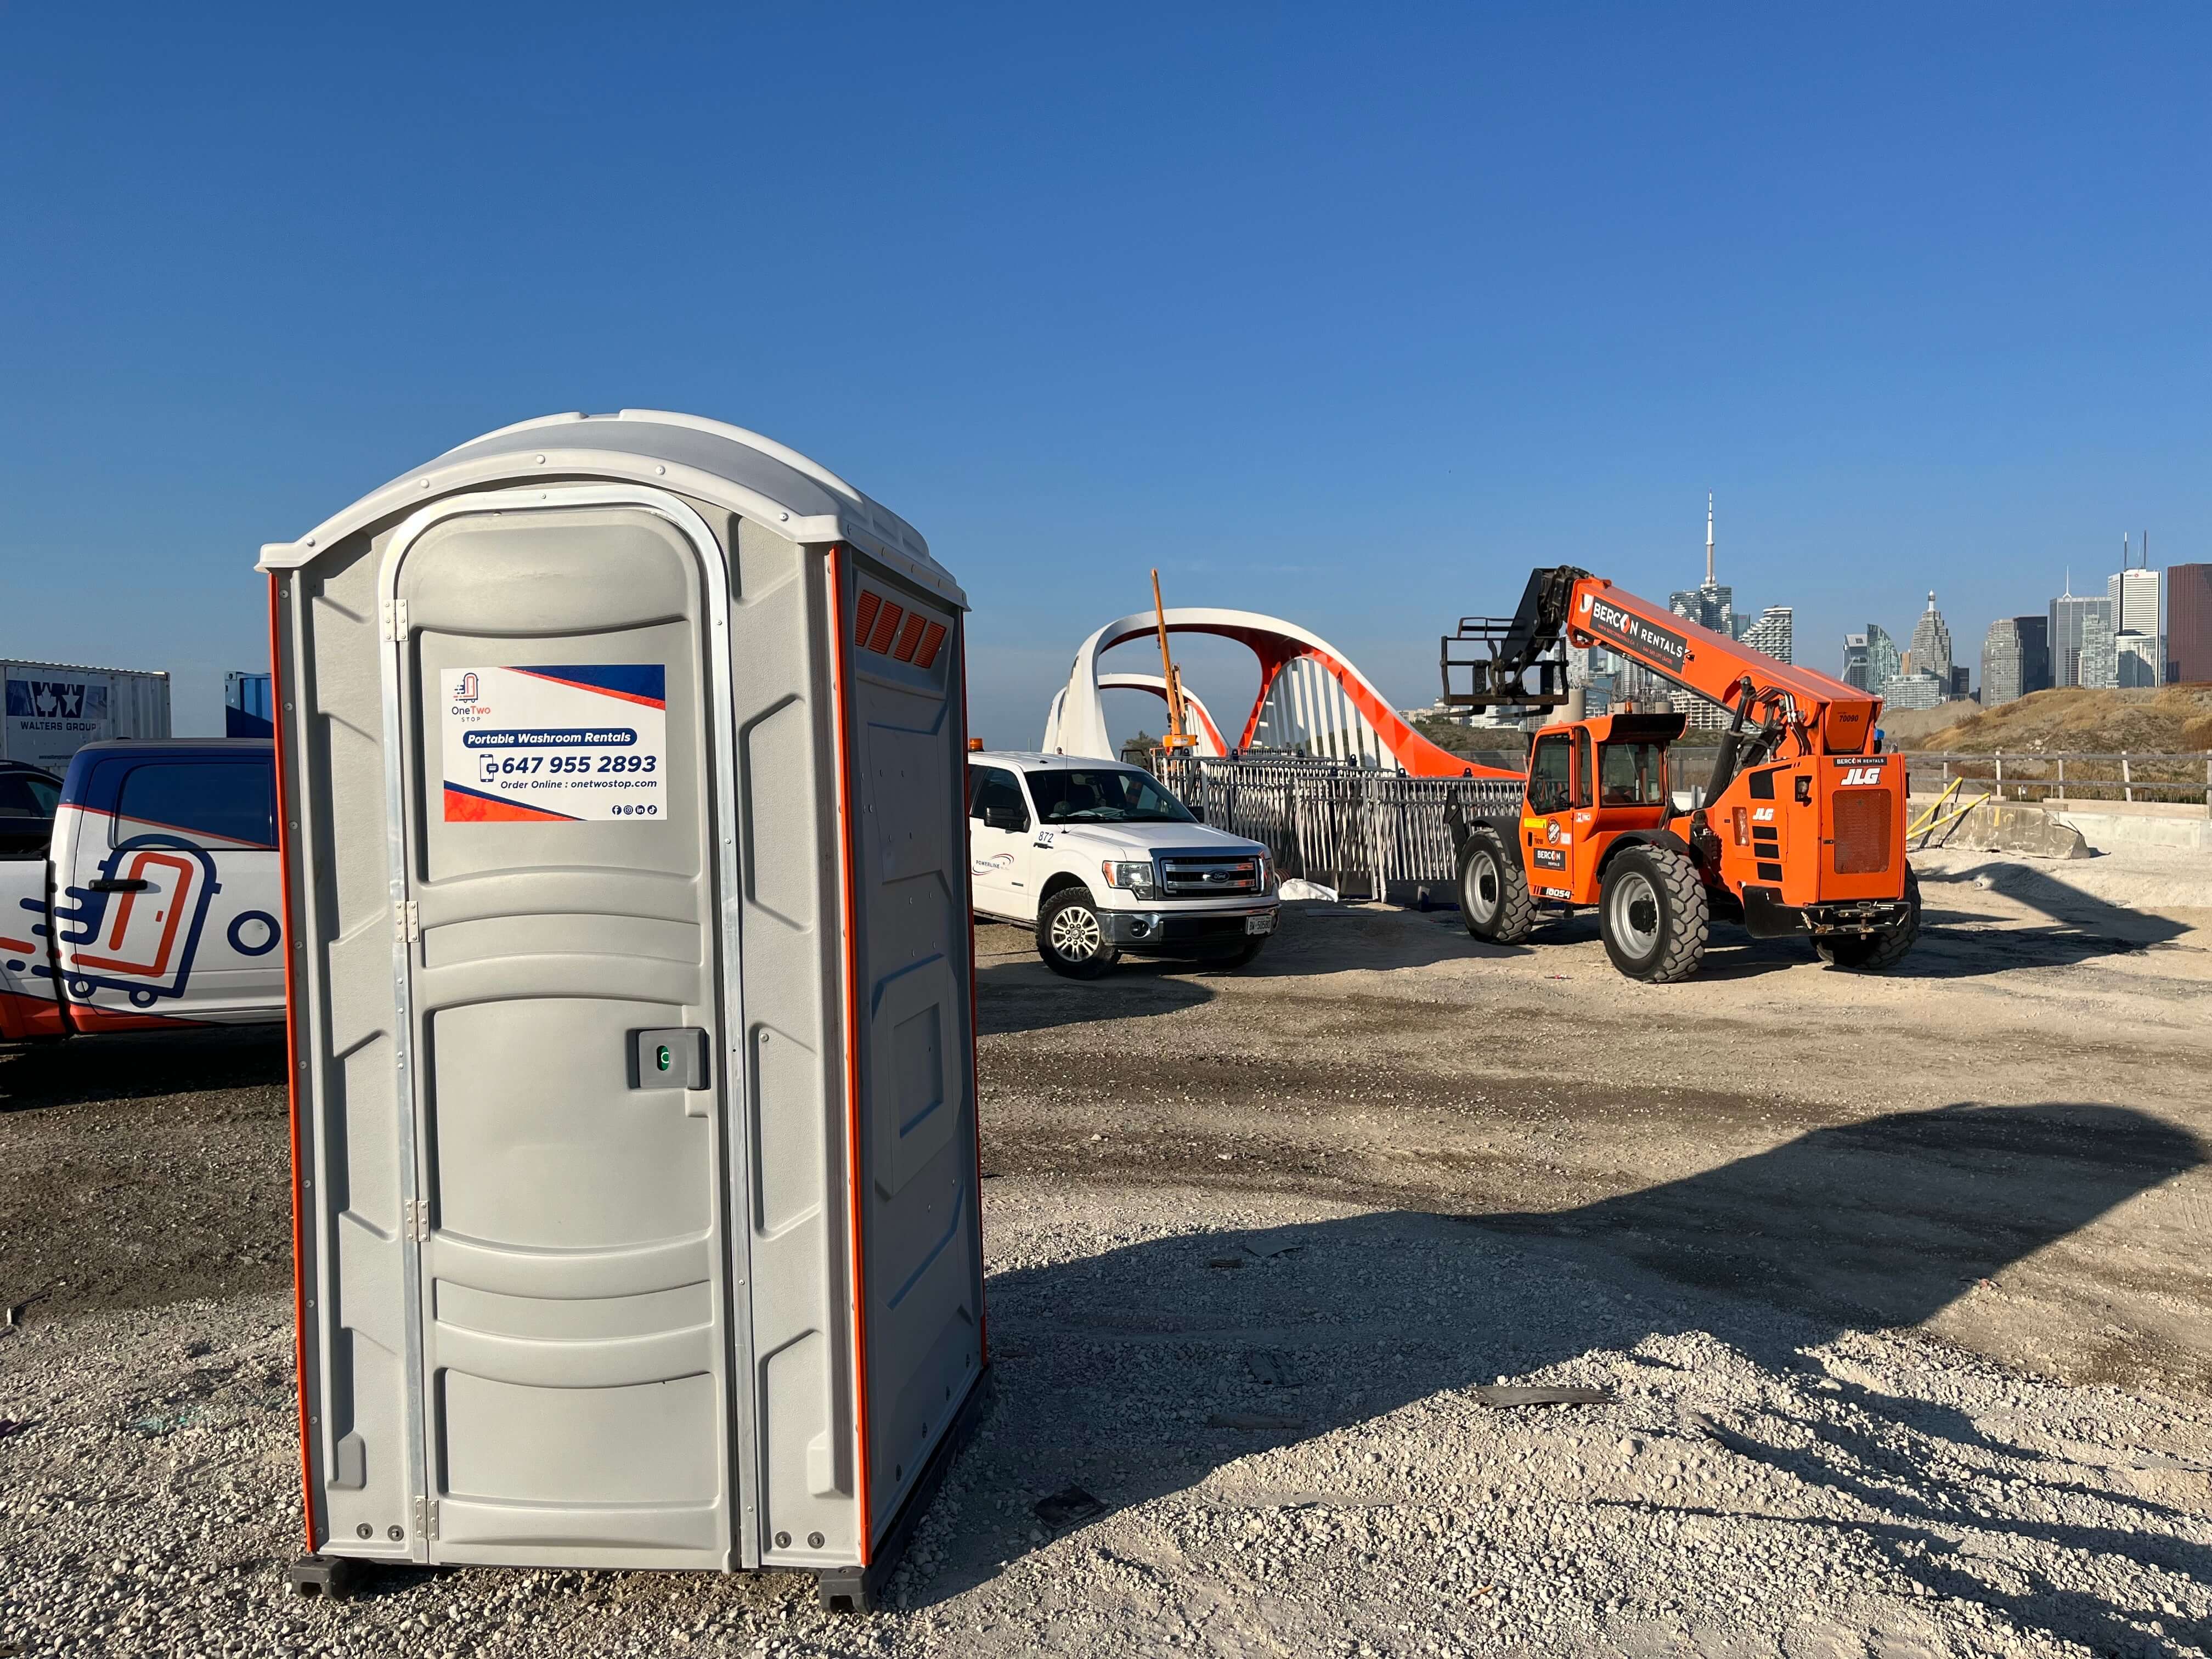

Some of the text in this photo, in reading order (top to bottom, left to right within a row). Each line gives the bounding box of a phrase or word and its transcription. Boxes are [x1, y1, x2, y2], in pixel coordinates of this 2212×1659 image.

[1593, 602, 1638, 636] BERCON
[1641, 628, 1683, 658] RENTALS
[452, 706, 490, 715] OneTwo
[20, 721, 97, 731] WALTERS GROUP
[467, 731, 631, 744] Portable Washroom Rentals
[502, 755, 657, 774] 647 955 2893
[1840, 768, 1881, 786] JLG
[501, 780, 528, 789] Order
[532, 780, 562, 788] Online
[571, 780, 657, 790] onetwostop.com
[1752, 808, 1774, 821] JLG
[1038, 831, 1054, 843] 872
[1537, 850, 1560, 861] BERCON
[976, 860, 1000, 869] POWERLINE
